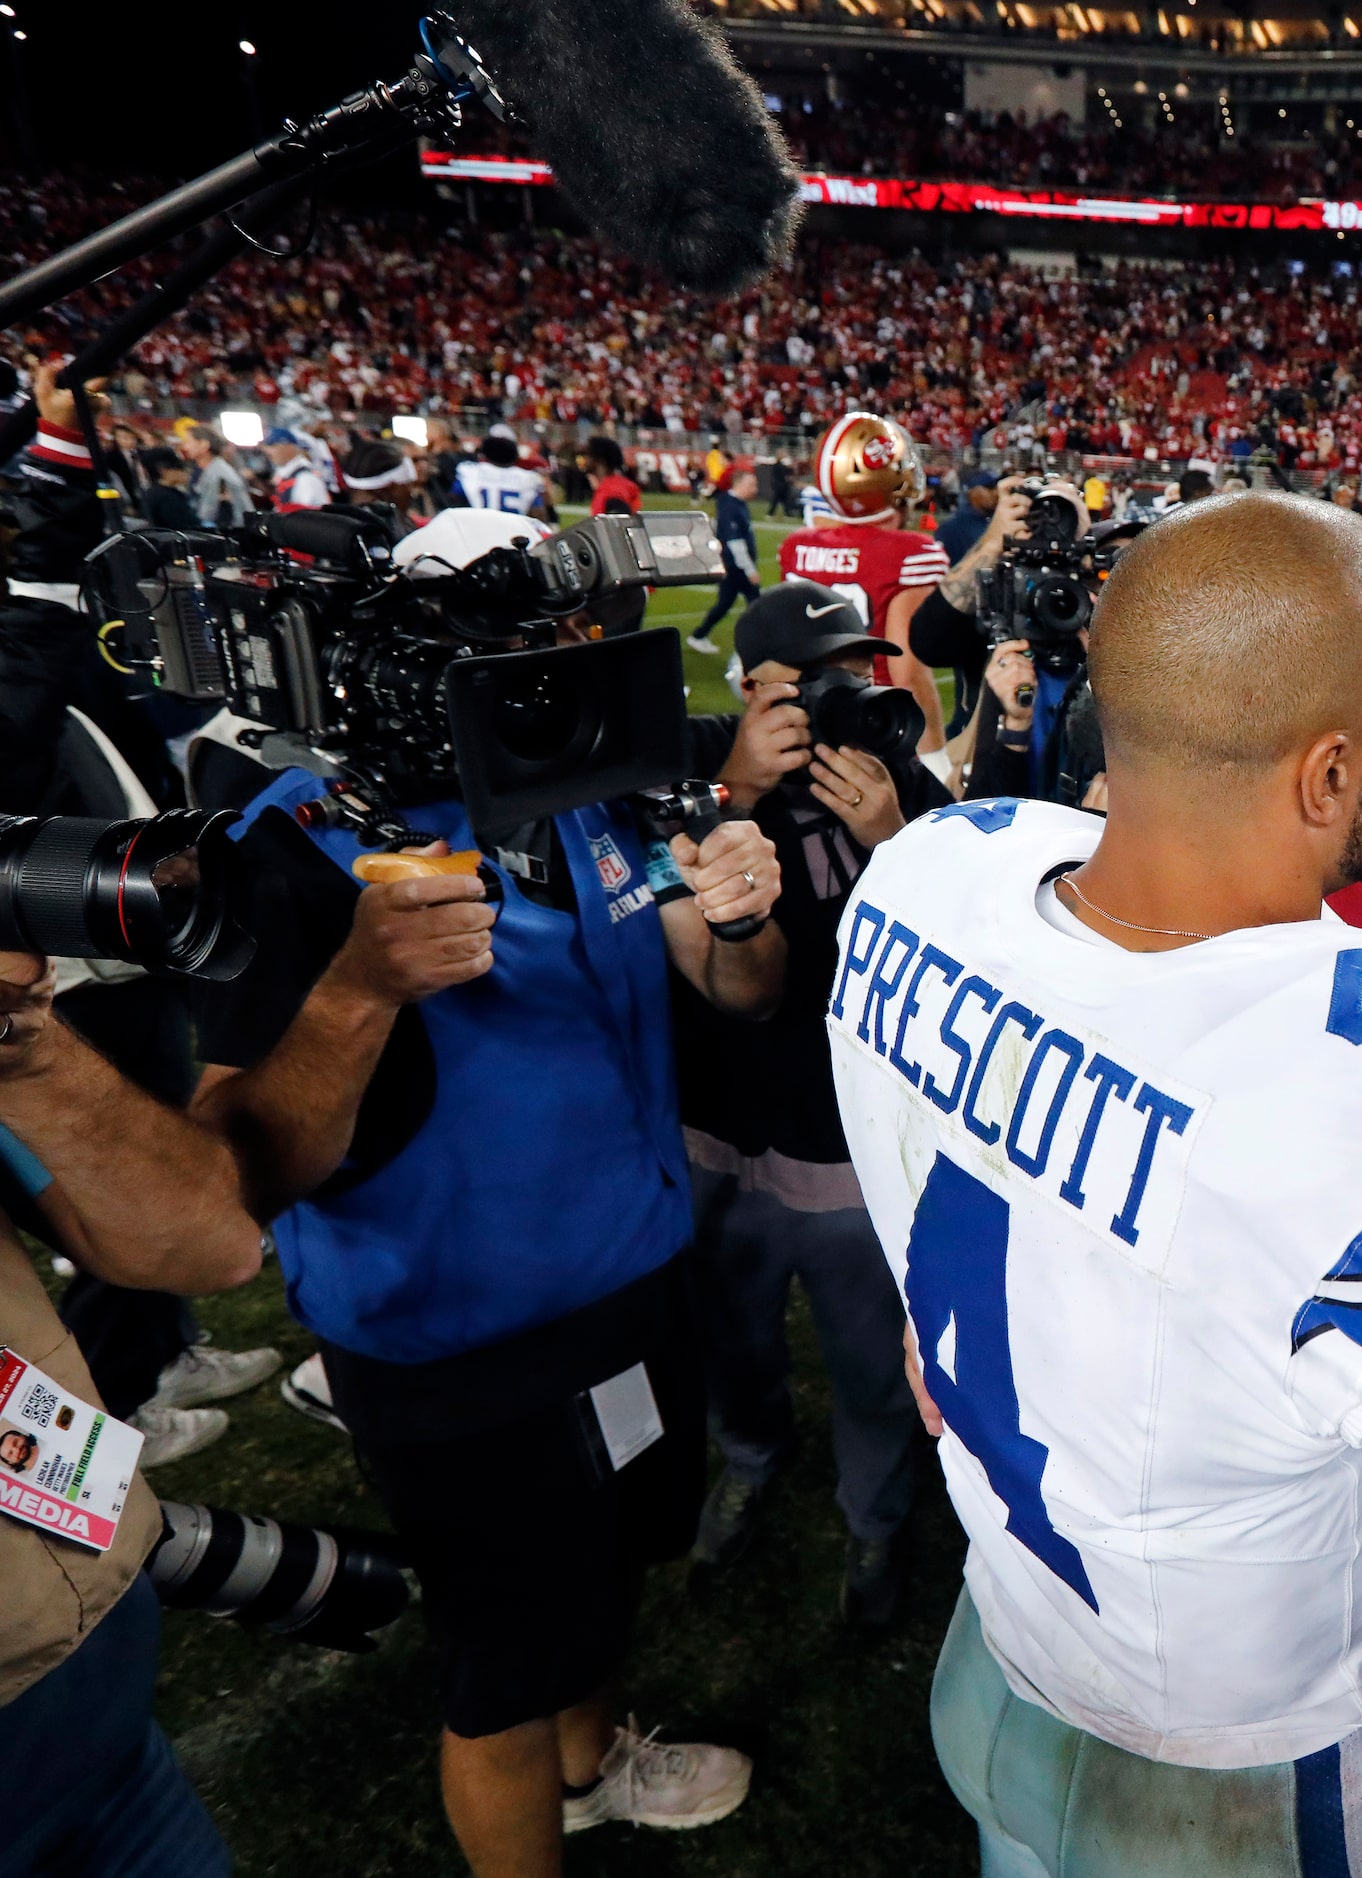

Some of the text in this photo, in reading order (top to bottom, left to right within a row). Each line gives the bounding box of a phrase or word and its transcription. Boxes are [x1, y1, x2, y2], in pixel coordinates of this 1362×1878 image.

[795, 545, 860, 574] TONGES
[831, 900, 1196, 1248] PRESCOTT
[903, 1149, 1101, 1617] 4
[72, 1421, 102, 1488] FULL FIELD ACCESS
[0, 1479, 90, 1538] MEDIA
